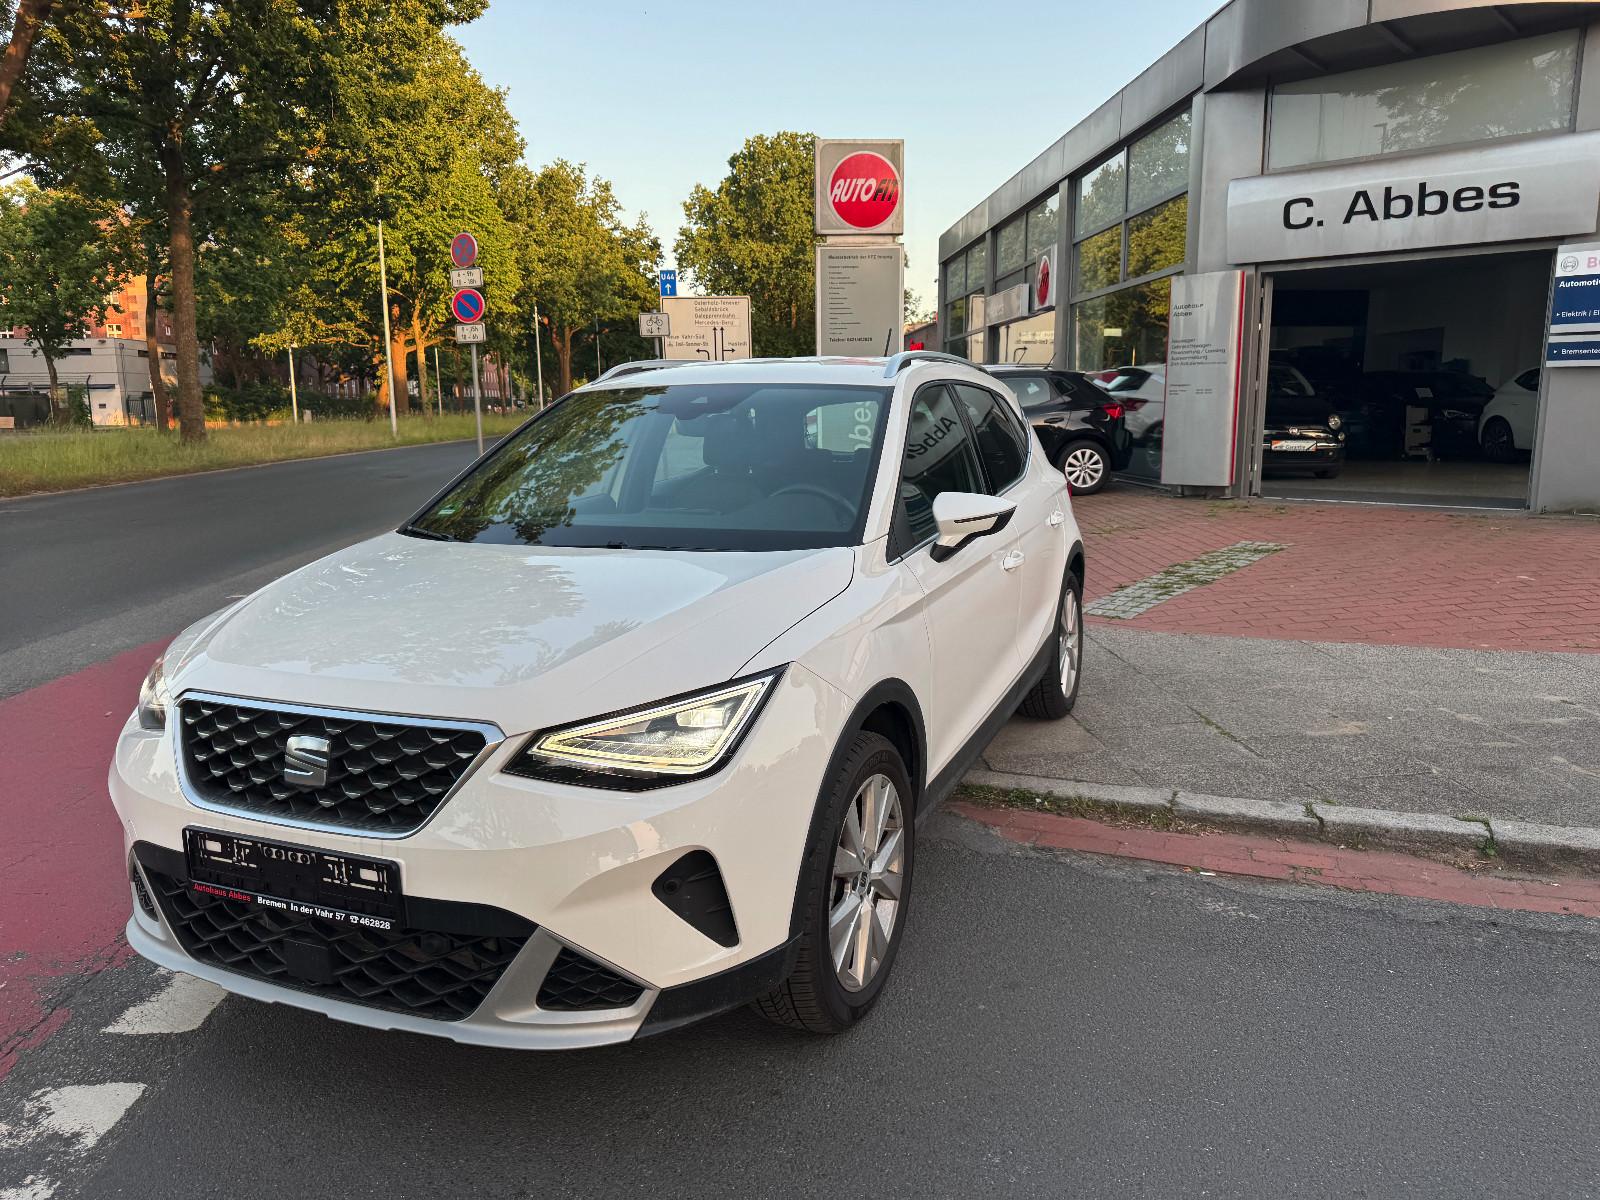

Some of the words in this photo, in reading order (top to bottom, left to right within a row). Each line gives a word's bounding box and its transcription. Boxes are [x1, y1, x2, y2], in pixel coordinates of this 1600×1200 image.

[1283, 197, 1324, 230] C.
[1342, 181, 1520, 225] Abbes
[1586, 256, 1600, 268] B
[1559, 277, 1600, 288] Automoti
[193, 883, 227, 897] Autohaus
[228, 888, 251, 902] Abbes
[257, 896, 287, 910] Bremen
[290, 903, 299, 911] In
[299, 905, 314, 915] der
[315, 907, 334, 919] Vahr
[335, 912, 346, 921] 57
[359, 917, 391, 930] 462828
